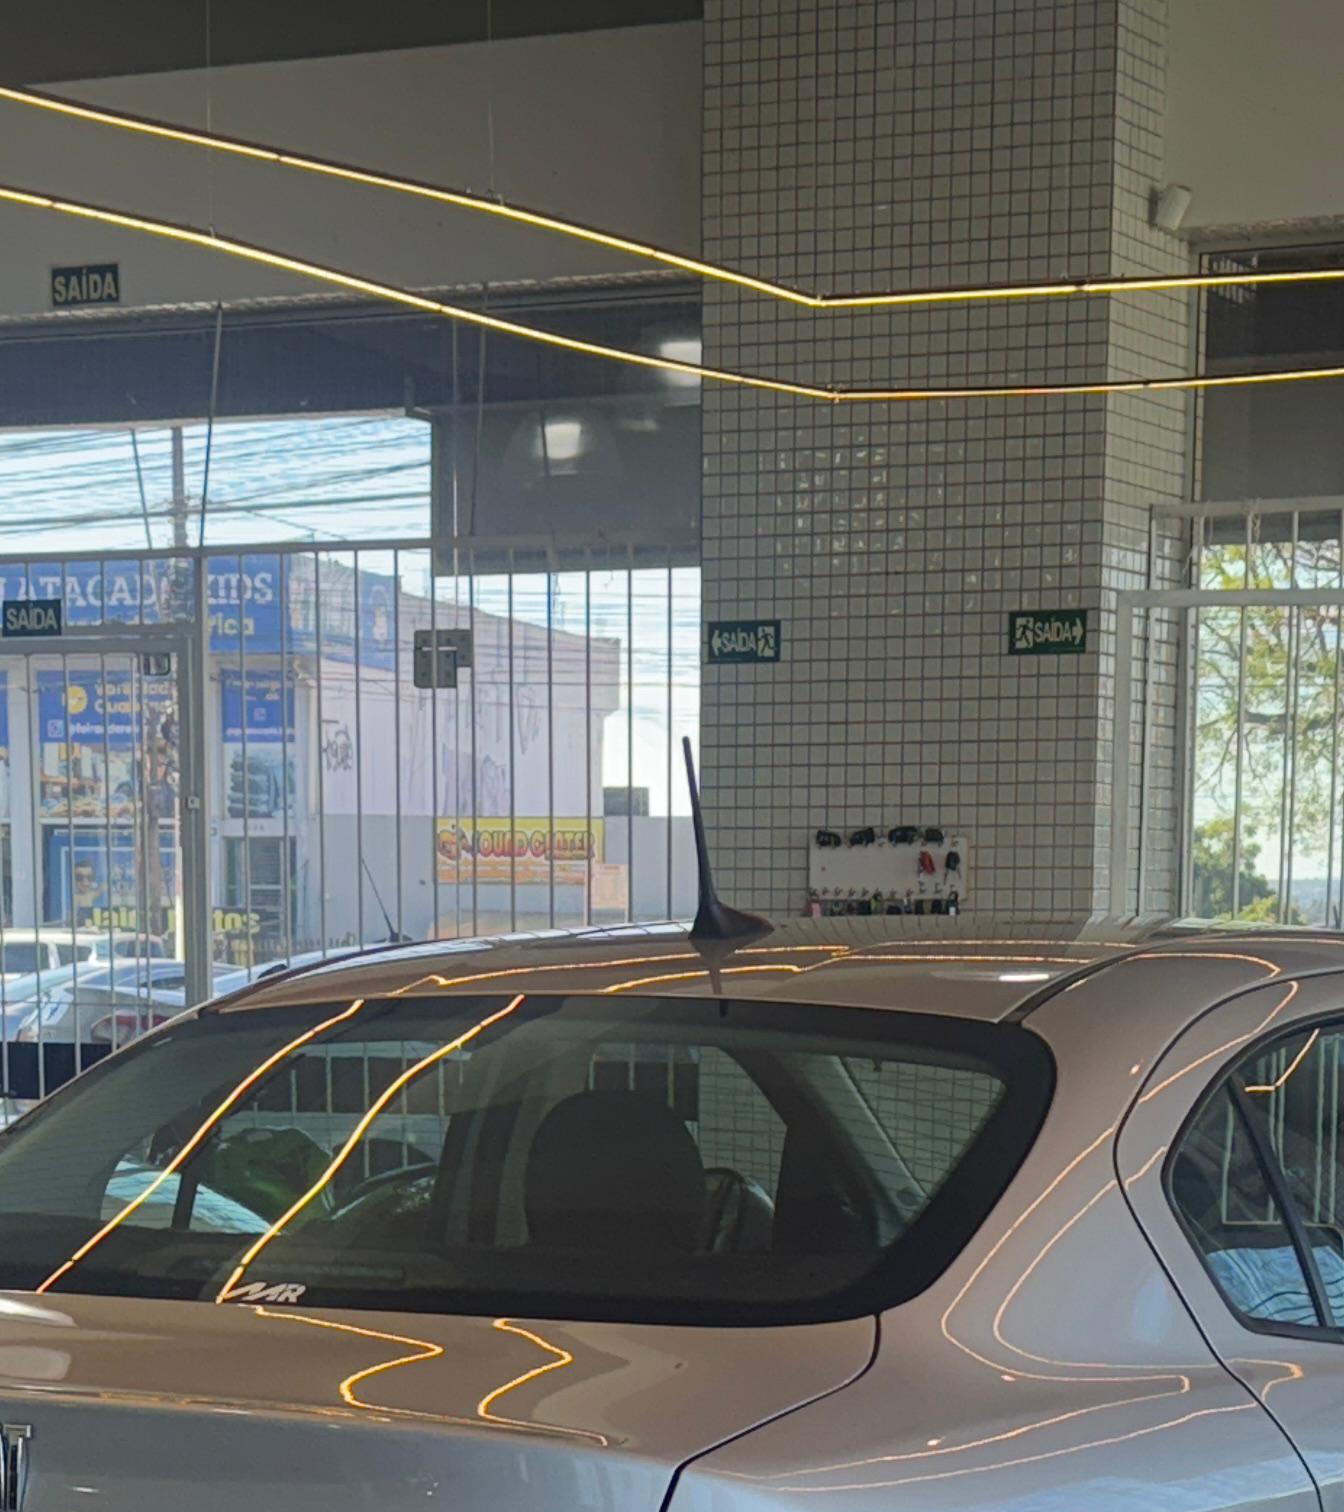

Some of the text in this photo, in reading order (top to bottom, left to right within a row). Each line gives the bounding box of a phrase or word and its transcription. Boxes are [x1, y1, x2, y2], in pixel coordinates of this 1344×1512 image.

[54, 268, 118, 303] SAÍDA
[6, 602, 58, 631] SAÍDA
[1035, 616, 1072, 643] SAÍDA
[722, 627, 756, 652] SAÍDA
